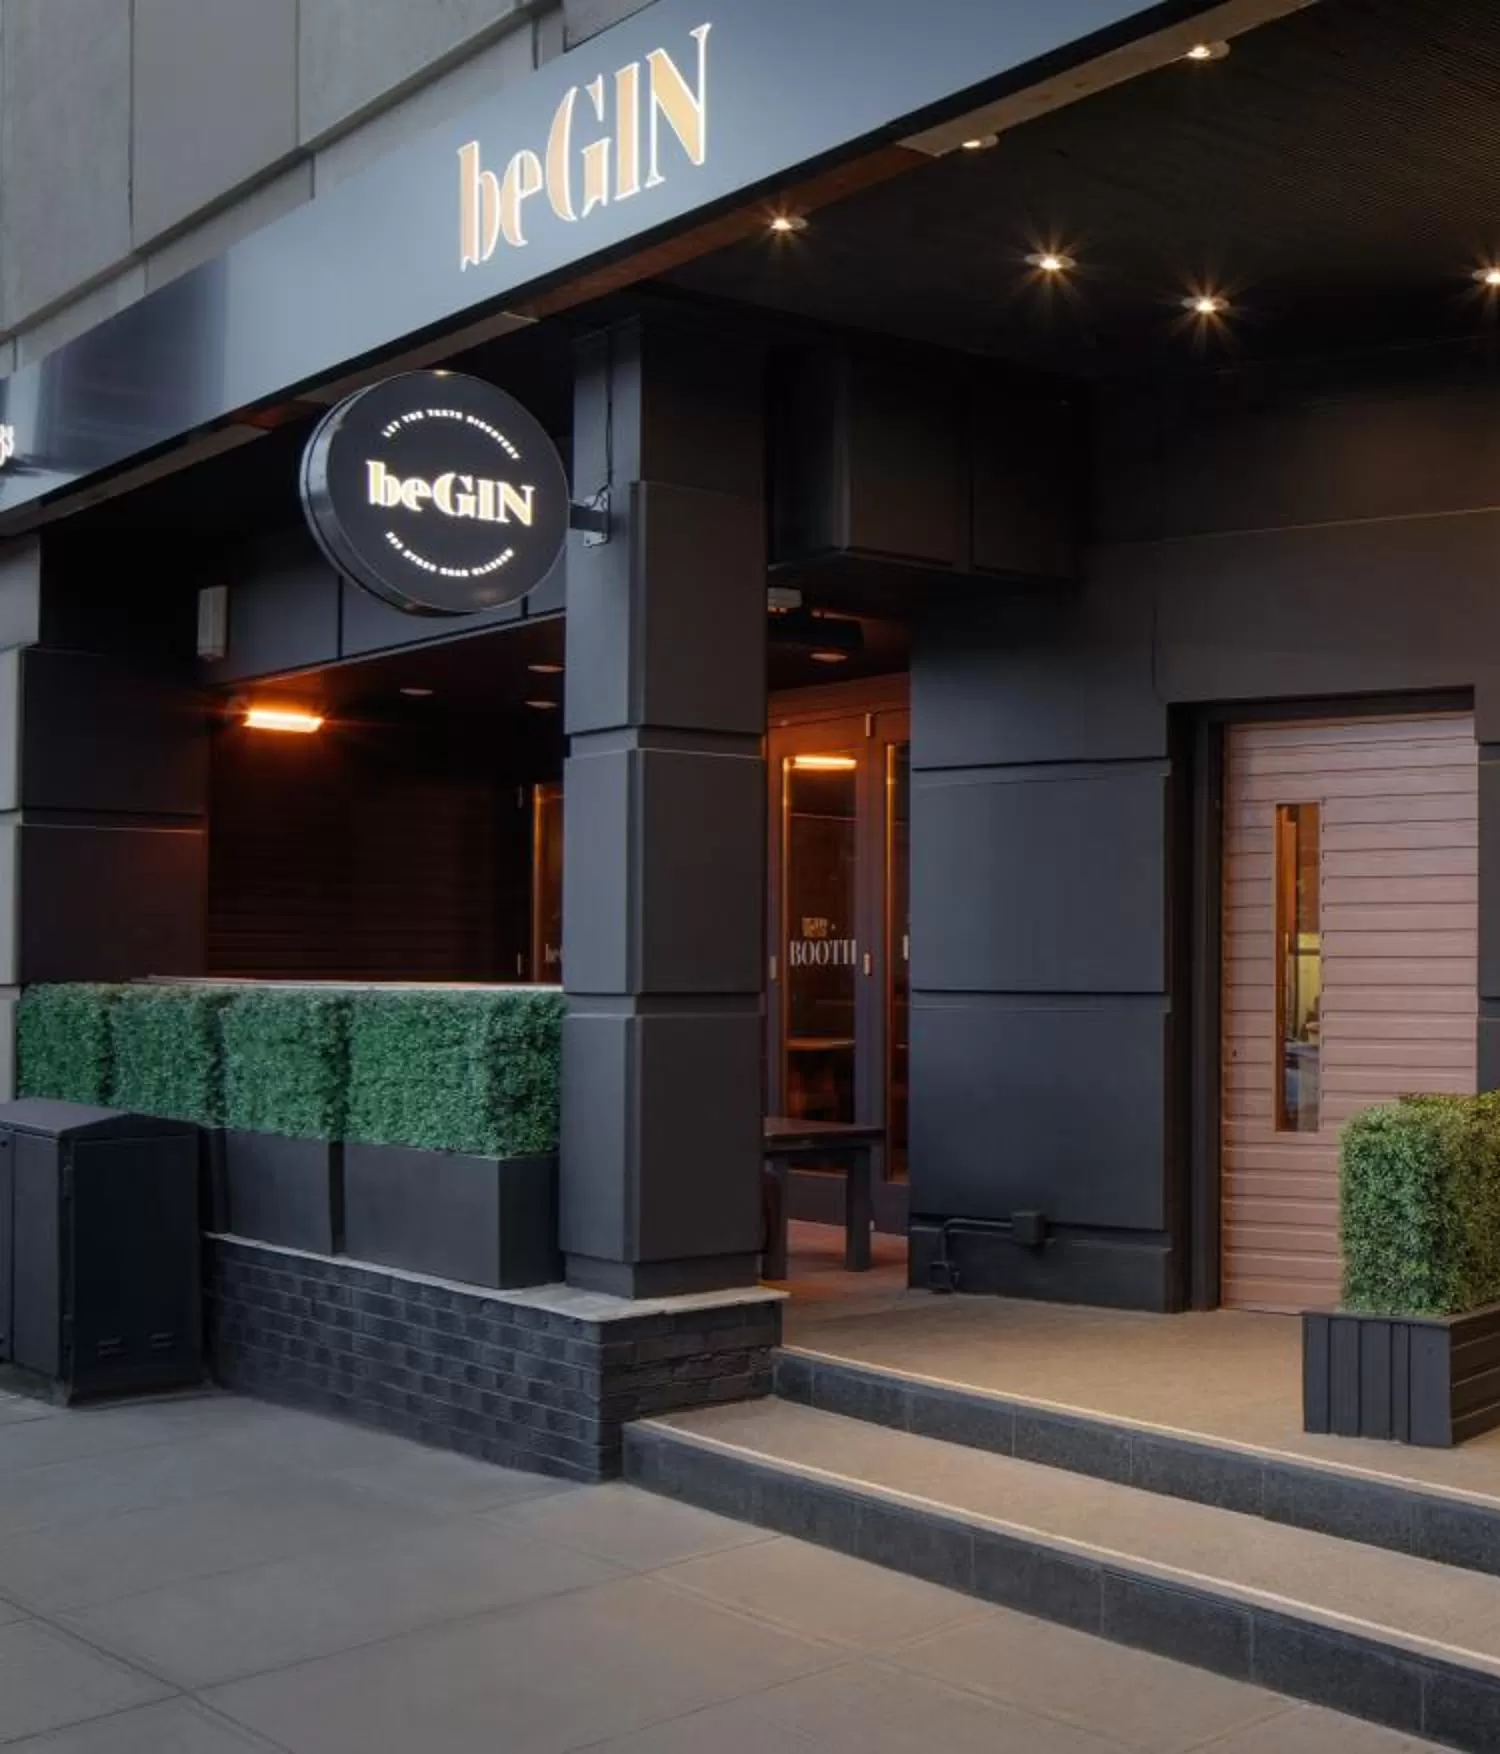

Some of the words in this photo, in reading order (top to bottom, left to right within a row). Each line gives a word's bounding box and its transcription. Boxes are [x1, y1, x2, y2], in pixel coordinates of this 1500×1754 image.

[457, 22, 712, 272] beGIN
[366, 459, 536, 526] beGIN
[790, 939, 857, 966] BOOTH
